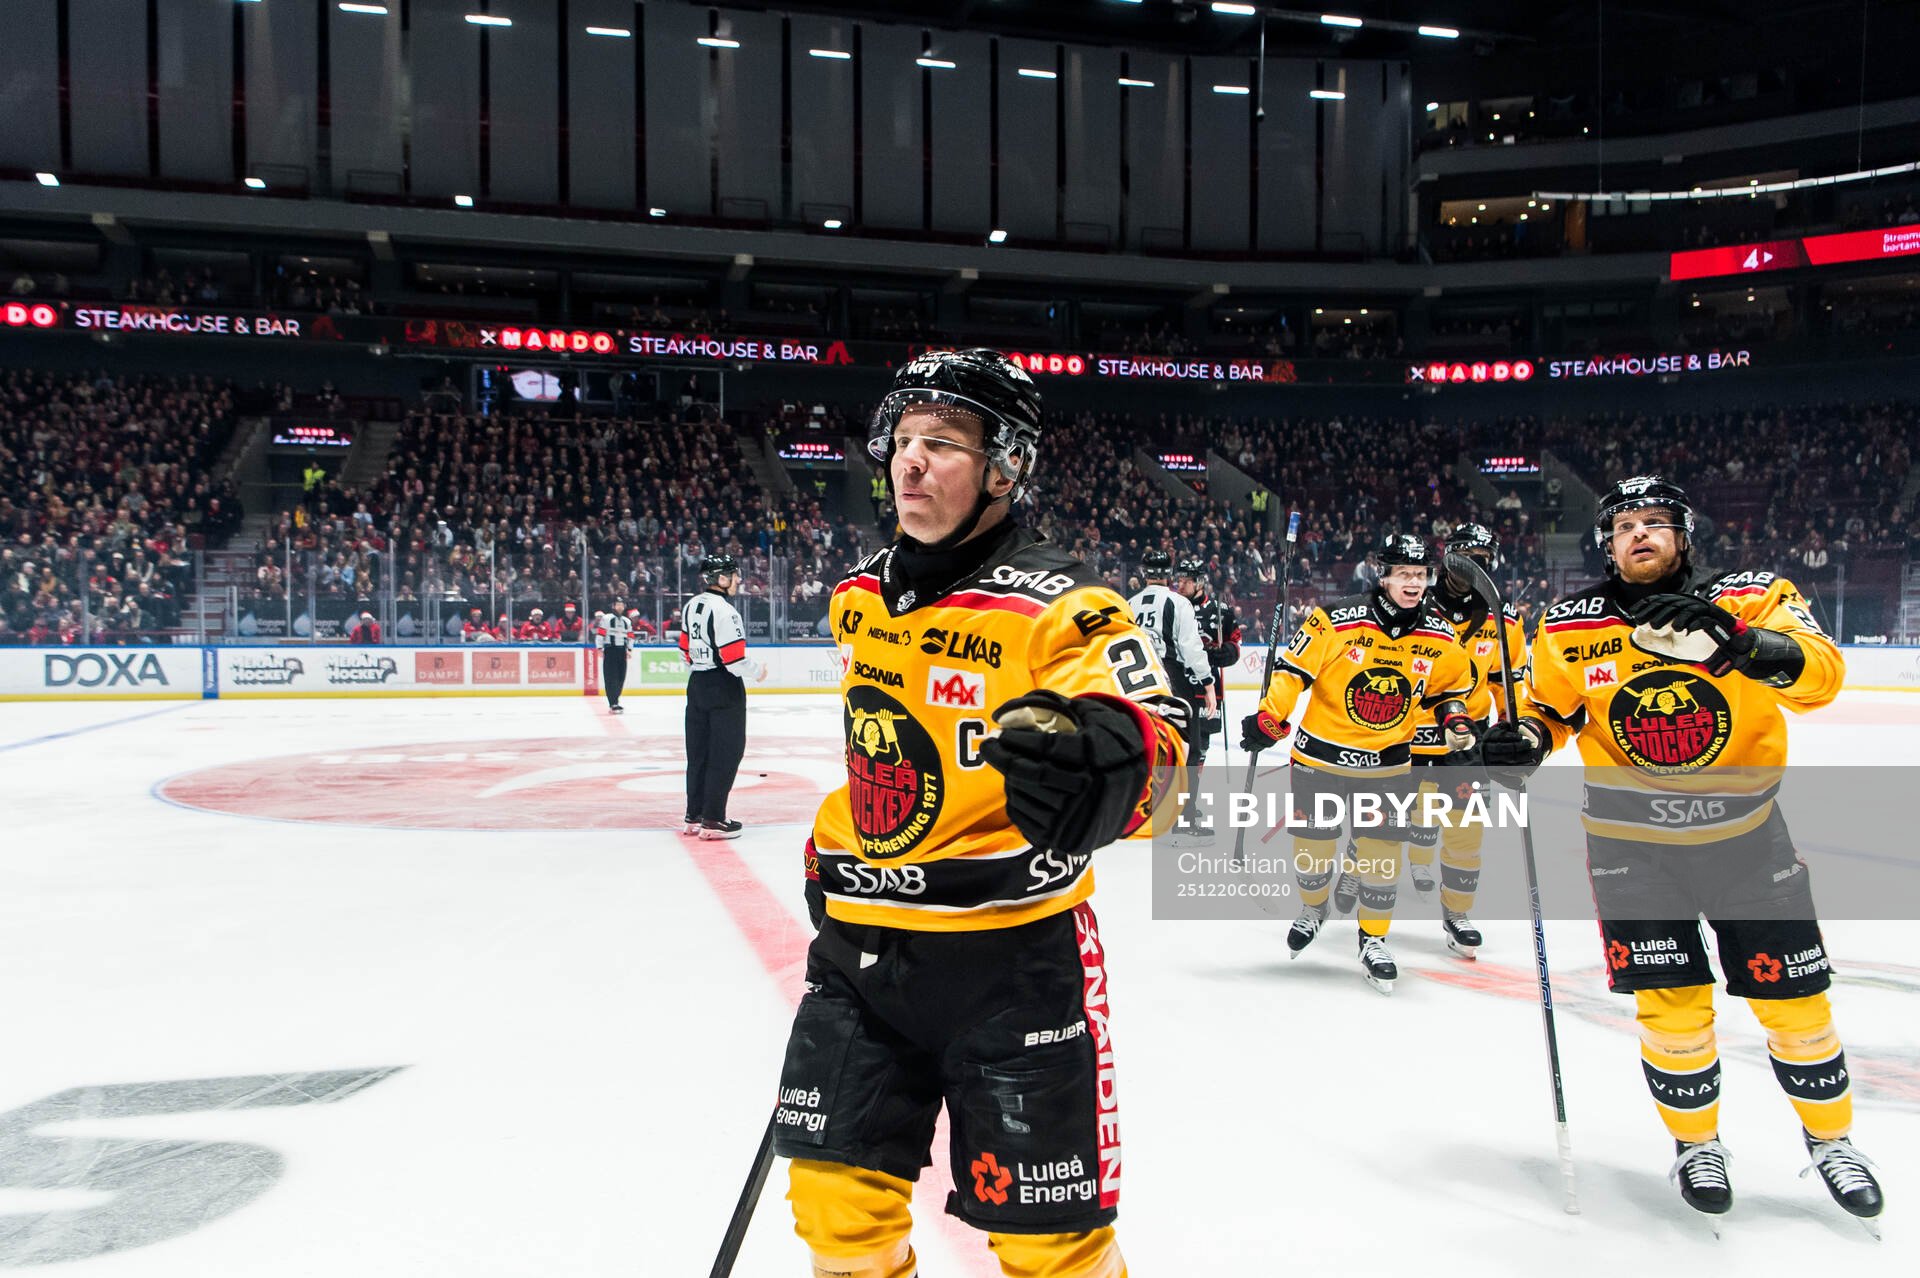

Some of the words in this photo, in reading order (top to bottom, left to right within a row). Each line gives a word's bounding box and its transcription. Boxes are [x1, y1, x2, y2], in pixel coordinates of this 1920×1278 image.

[75, 309, 229, 333] STEAKHOUSE
[233, 318, 250, 334] &
[255, 319, 301, 336] BAR
[501, 329, 612, 352] MANDO
[629, 336, 760, 359] STEAKHOUSE
[763, 343, 777, 360] &
[781, 344, 819, 361] BAR
[1010, 354, 1083, 374] ANDO
[1098, 359, 1210, 379] STEAKHOUSE
[1213, 364, 1226, 379] &
[1229, 365, 1264, 380] BAR
[1429, 362, 1532, 381] MANDO
[1549, 355, 1683, 379] STEAKHOUSE
[1687, 354, 1702, 371] &
[1708, 350, 1751, 369] BAR
[979, 564, 1076, 596] SSAB
[1711, 571, 1775, 598] SSAB
[1331, 605, 1368, 623] SSAB
[1545, 596, 1606, 622] SSAB
[1424, 615, 1455, 636] SSAB
[947, 632, 1004, 670] LKAB
[1288, 630, 1312, 657] 91
[1581, 637, 1623, 661] LKAB
[44, 653, 170, 688] DOXA
[232, 668, 293, 684] HOCKEY
[328, 667, 386, 683] HOCKEY
[854, 661, 905, 688] SCANIA
[1588, 665, 1615, 688] MAX
[1632, 660, 1674, 673] SCAN
[932, 673, 980, 708] MAX
[1411, 679, 1426, 698] A
[1625, 706, 1714, 732] LULEÅ
[957, 718, 986, 769] C
[1612, 720, 1633, 752] LULEÅ
[1629, 736, 1725, 775] HOCKEYFÖRENING
[1716, 710, 1728, 734] 1977
[1627, 726, 1714, 763] HOCKEY
[1336, 751, 1382, 768] SSAB
[922, 772, 938, 809] 1977
[1649, 799, 1727, 824] SSAB
[837, 862, 927, 896] SSAB
[1630, 937, 1677, 952] Luleå
[1783, 944, 1823, 965] Luleå
[1633, 951, 1690, 968] Energi
[1023, 1019, 1087, 1048] BAUER
[779, 1085, 821, 1108] Luleå
[776, 1106, 827, 1132] Energi
[1017, 1154, 1085, 1183] Luleå
[1019, 1178, 1097, 1205] Energi
